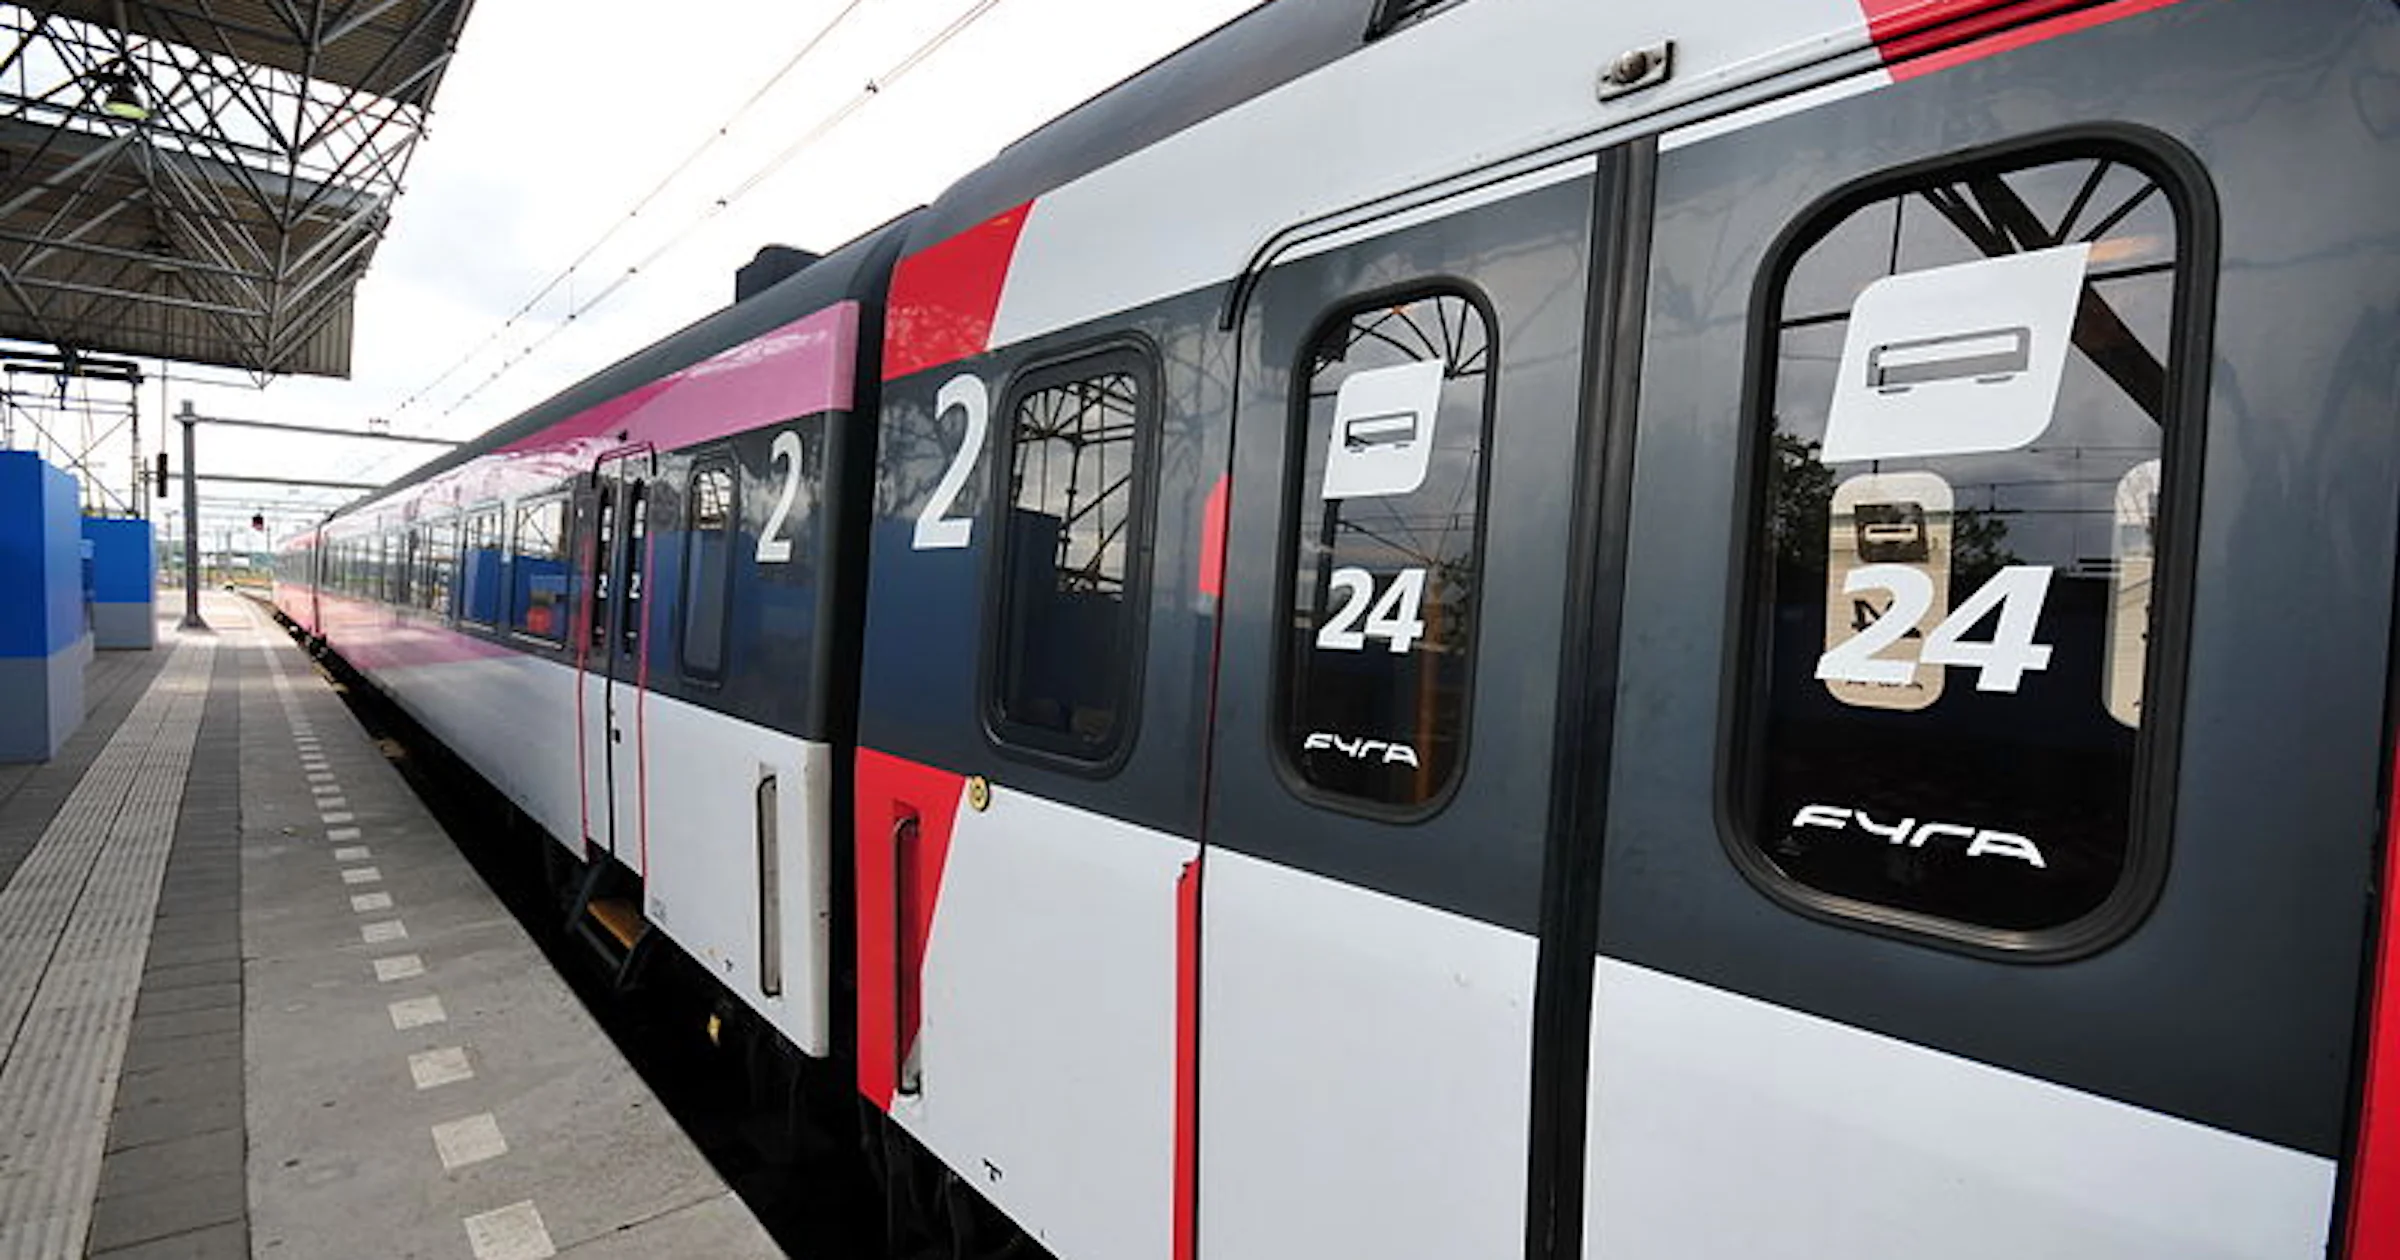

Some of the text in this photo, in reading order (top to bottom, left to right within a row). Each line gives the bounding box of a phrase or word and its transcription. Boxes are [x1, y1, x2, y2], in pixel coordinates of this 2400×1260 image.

[755, 430, 803, 563] 2
[912, 373, 989, 550] 2
[1316, 567, 1427, 654] 24
[1813, 562, 2054, 693] 24
